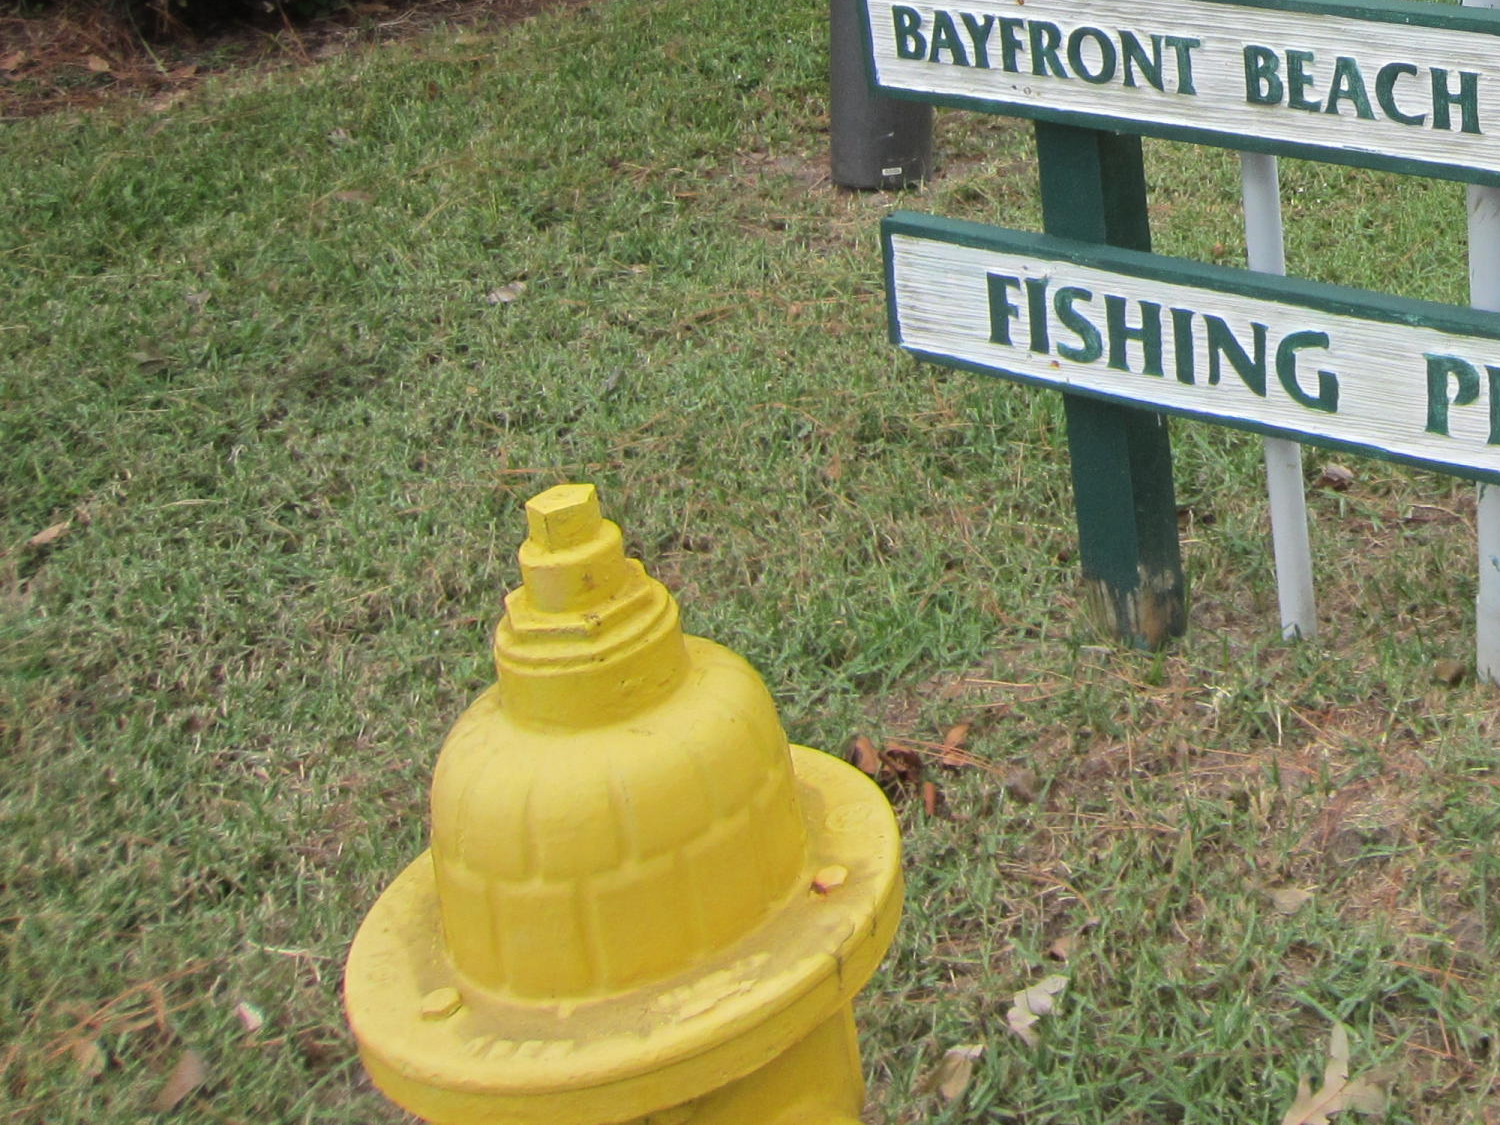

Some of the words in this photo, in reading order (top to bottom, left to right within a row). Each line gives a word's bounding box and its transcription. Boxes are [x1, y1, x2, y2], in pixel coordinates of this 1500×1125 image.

[893, 5, 1199, 95] BAYFRONT
[1244, 45, 1482, 135] BEACH
[986, 272, 1339, 413] FISHING
